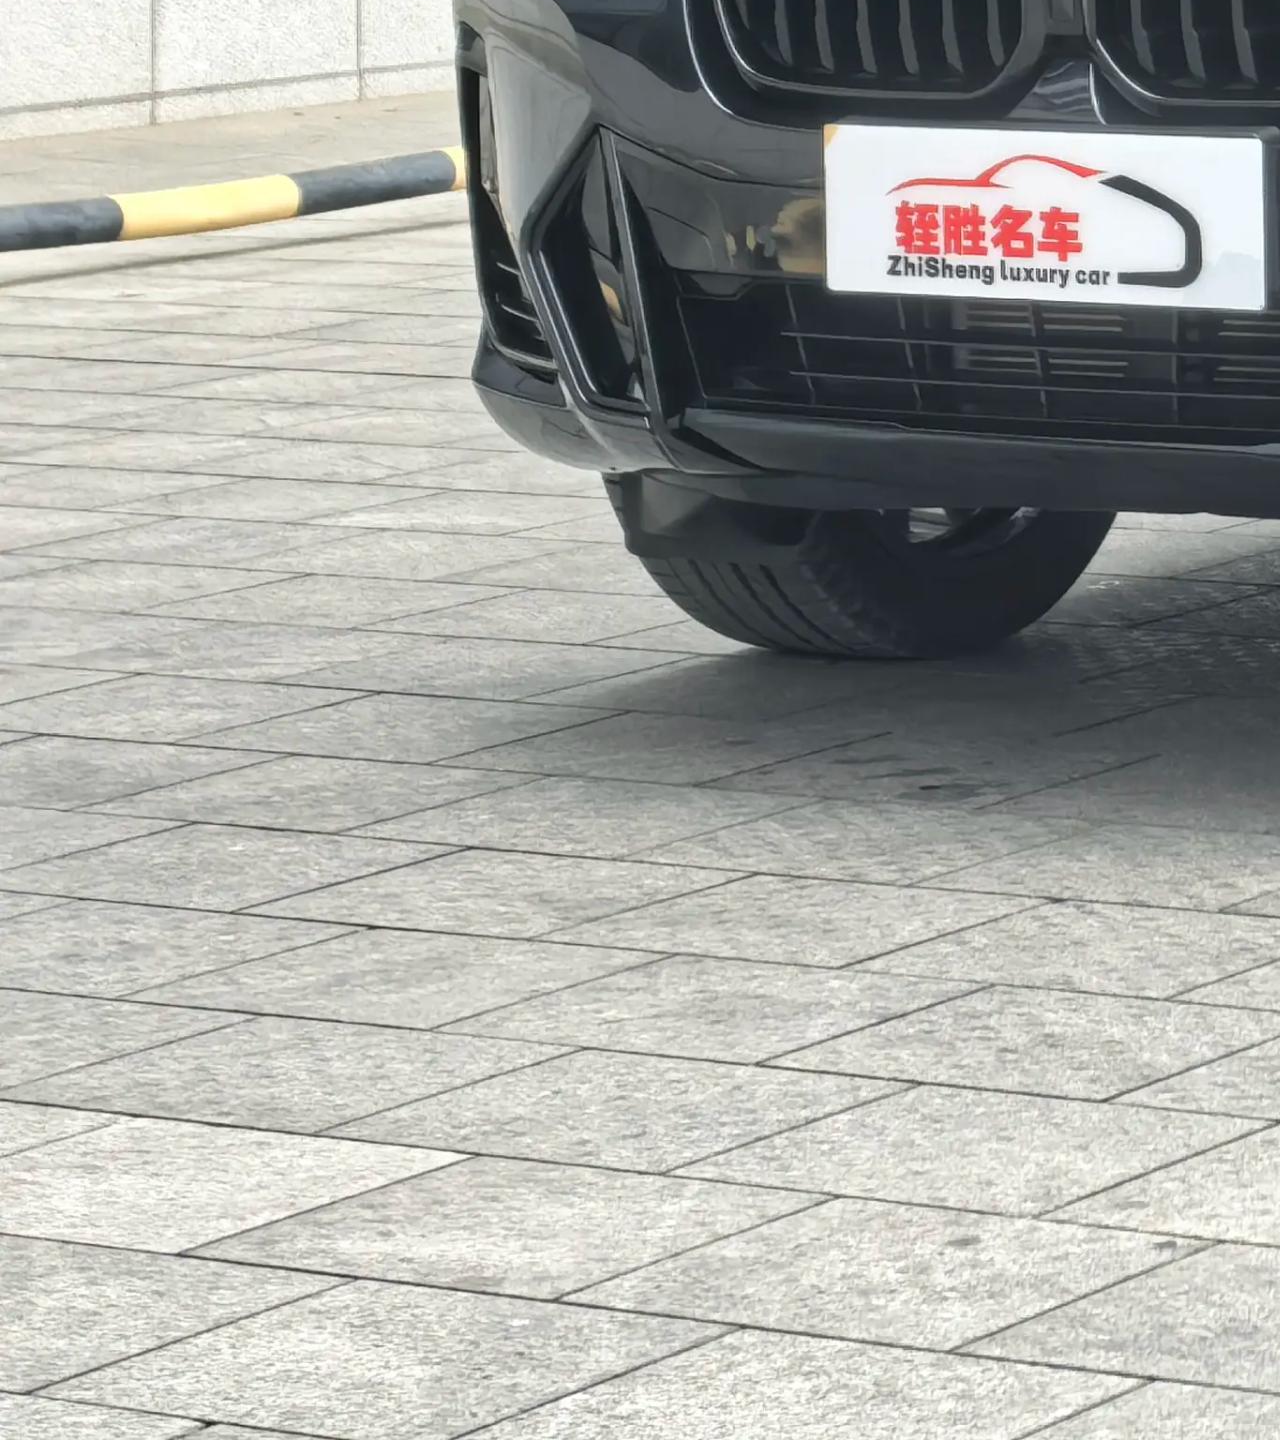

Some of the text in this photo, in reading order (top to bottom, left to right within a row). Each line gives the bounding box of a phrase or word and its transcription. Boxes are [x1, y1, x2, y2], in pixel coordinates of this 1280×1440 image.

[887, 254, 1111, 289] ZhiSheng luxury car
